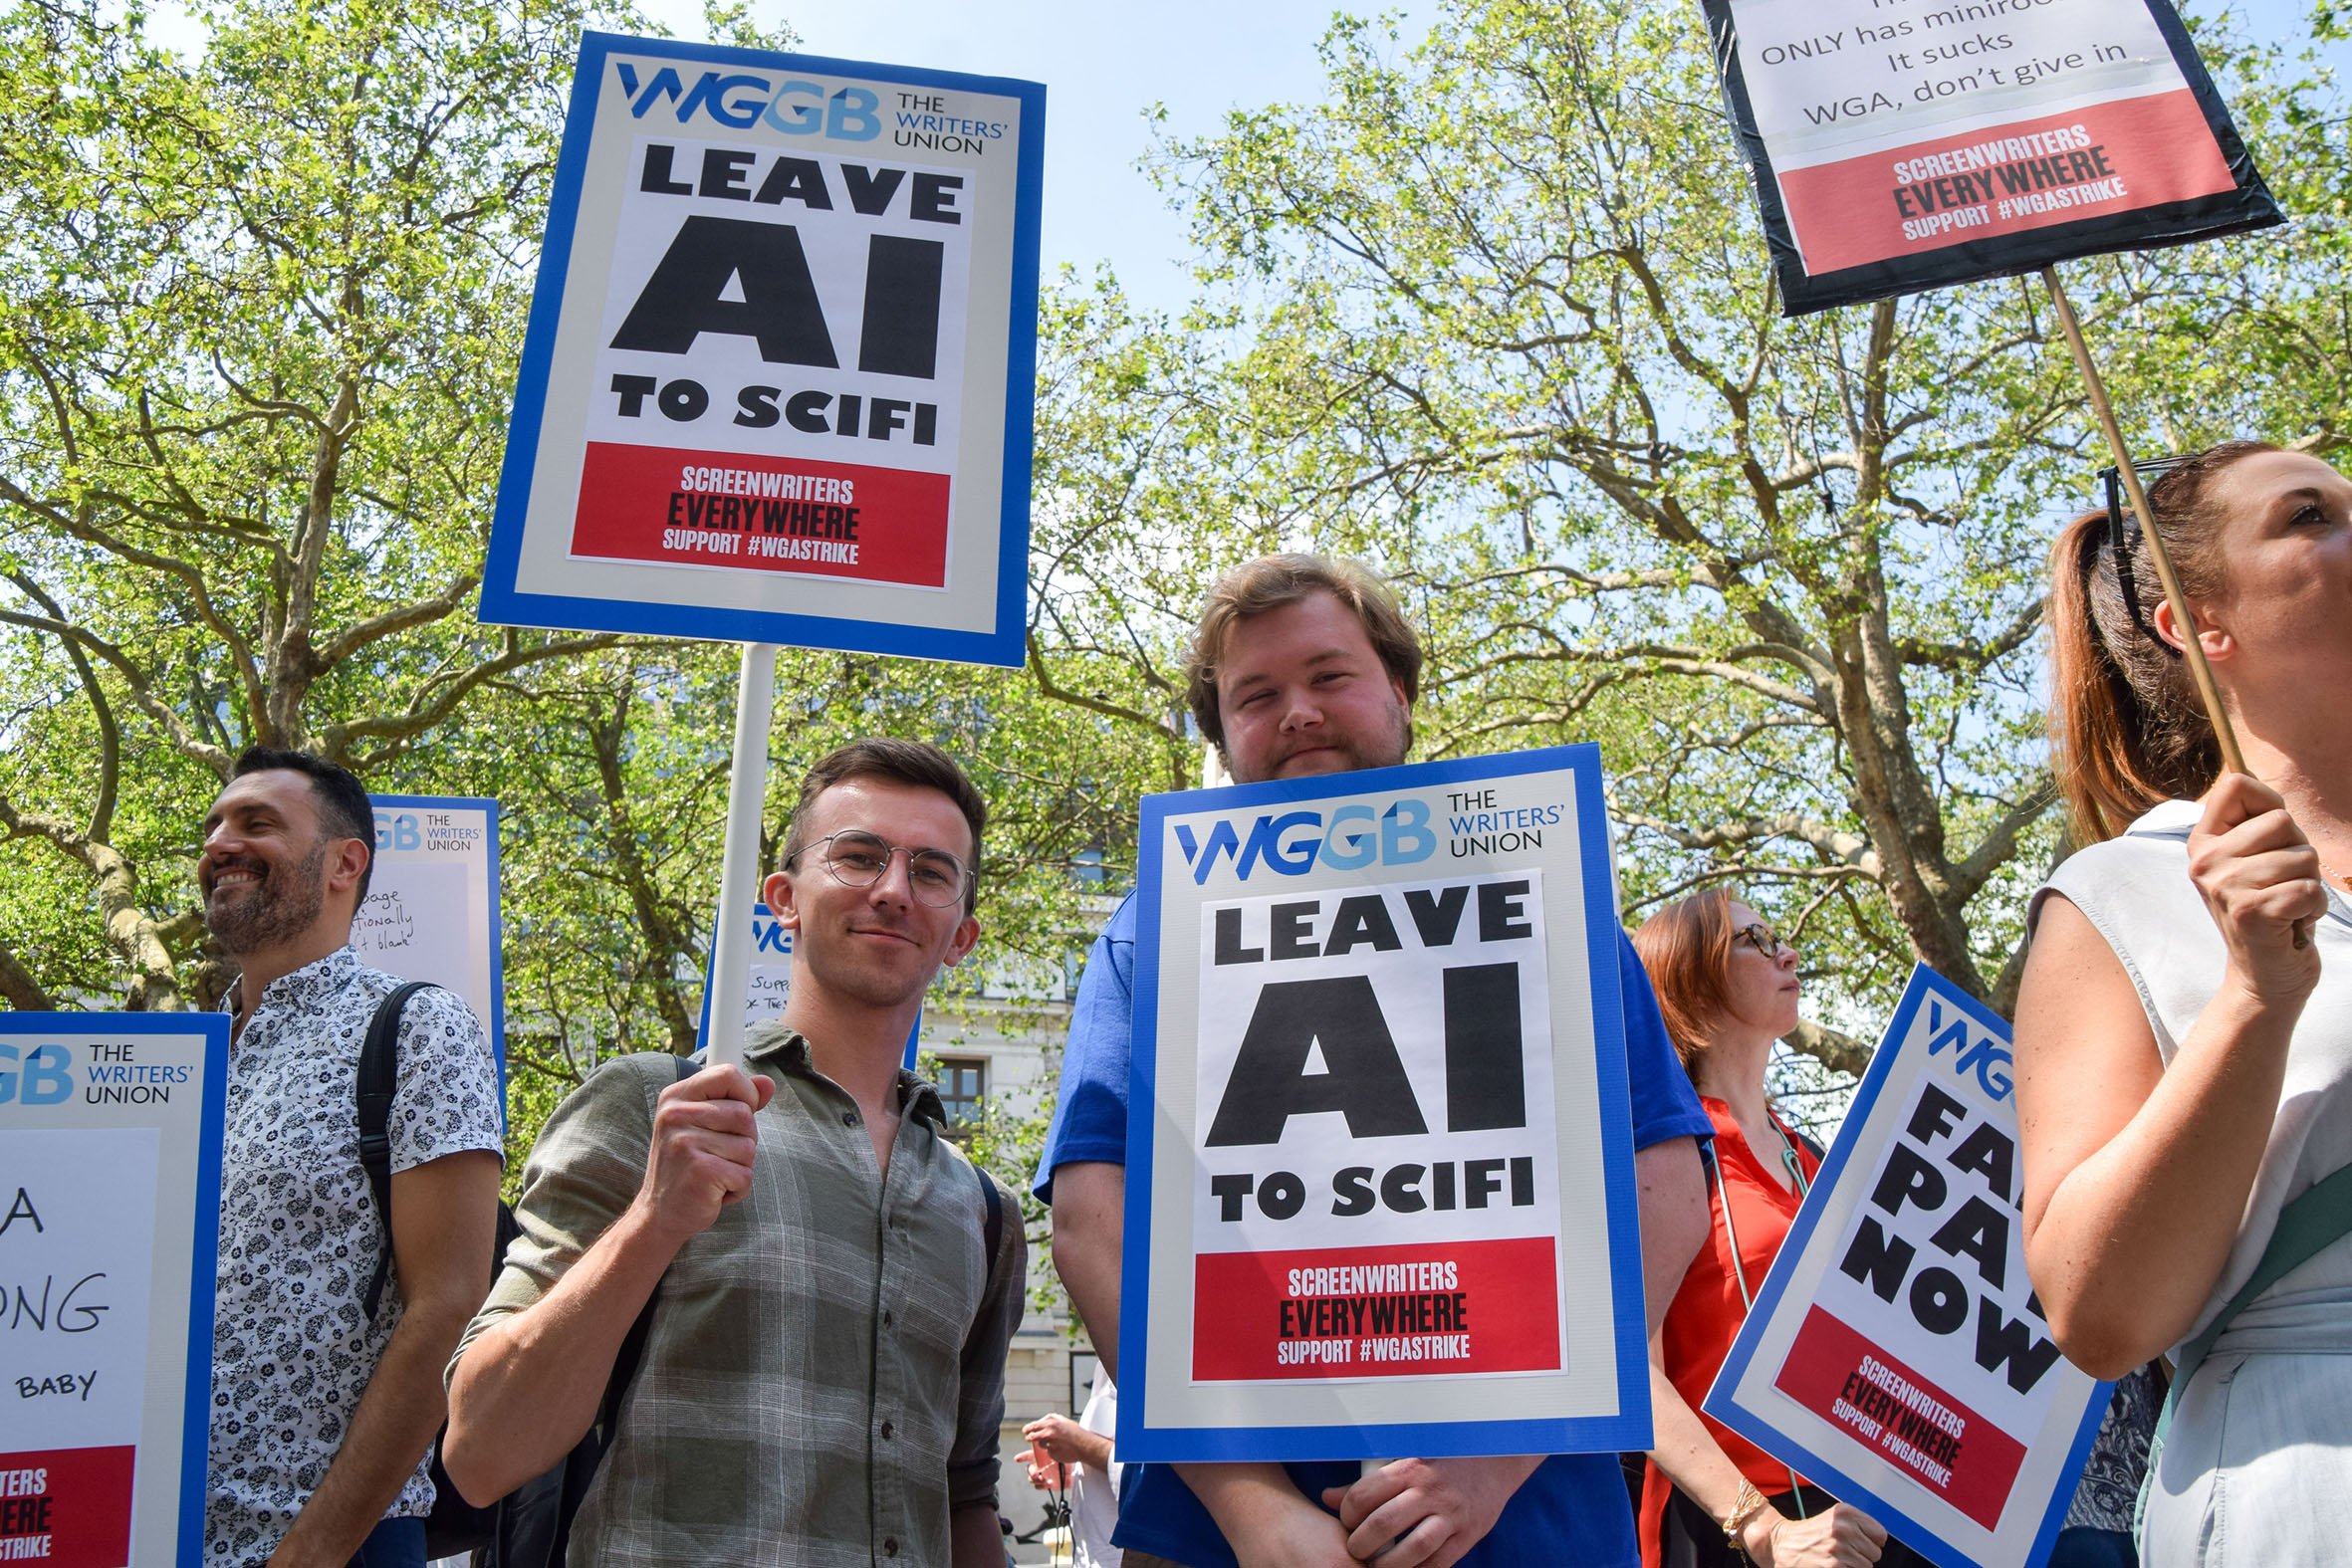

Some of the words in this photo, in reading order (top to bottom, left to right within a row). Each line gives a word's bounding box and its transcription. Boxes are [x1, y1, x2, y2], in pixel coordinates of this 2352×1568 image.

[1762, 31, 1843, 66] ONLY
[1856, 20, 1913, 46] has
[1887, 53, 1913, 73] It
[1923, 32, 2013, 65] sucks
[616, 63, 882, 141] WGGB
[896, 93, 944, 112] THE
[1803, 92, 1903, 125] WGA,
[1913, 68, 2004, 103] don't
[2014, 53, 2083, 87] give
[2094, 42, 2127, 63] in
[894, 129, 983, 155] UNION
[895, 112, 1008, 139] WRITERS'
[1893, 124, 2091, 184] SCREENWRITERS
[640, 144, 964, 225] LEAVE
[1893, 144, 2115, 218] EVERYWHERE
[1902, 205, 1991, 241] SUPPORT
[1998, 176, 2128, 219] #WGASTRIKE
[608, 215, 944, 379] AI
[610, 374, 709, 422] TO
[733, 385, 937, 446] SCIFI
[681, 466, 854, 505] SCREENWRITERS
[667, 492, 860, 541] EVERYWHERE
[662, 528, 742, 555] SUPPORT
[748, 536, 859, 564] #WGASTRIKE
[427, 814, 450, 825] THE
[1447, 789, 1498, 812] THE
[1449, 804, 1565, 835] WRITERS'
[427, 840, 471, 851] UNION
[1174, 799, 1437, 885] WGGB
[1450, 830, 1542, 858] UNION
[378, 931, 410, 950] blank
[1214, 880, 1531, 966] LEAVE
[88, 1066, 193, 1083] WRITERS'
[90, 1044, 134, 1061] THE
[1204, 962, 1528, 1148] AI
[86, 1086, 169, 1104] UNION
[1907, 1081, 2023, 1212] FA
[1211, 1169, 1305, 1222] TO
[1331, 1157, 1534, 1217] SCIFI
[1871, 1141, 2047, 1322] PA
[0, 1272, 110, 1332] NG
[1289, 1260, 1459, 1297] SCREENWRITERS
[1280, 1293, 1468, 1338] EVERYWHERE
[1840, 1215, 2061, 1395] NOW
[1278, 1339, 1352, 1365] SUPPORT
[1360, 1335, 1471, 1362] #WGASTRIKE
[16, 1370, 98, 1401] BABY
[1859, 1355, 1966, 1439] SCREENWRITERS
[1832, 1398, 1883, 1441] SUPPORT
[1882, 1432, 1952, 1488] #WGASTRIKE
[1841, 1371, 1962, 1469] EVERYWHERE
